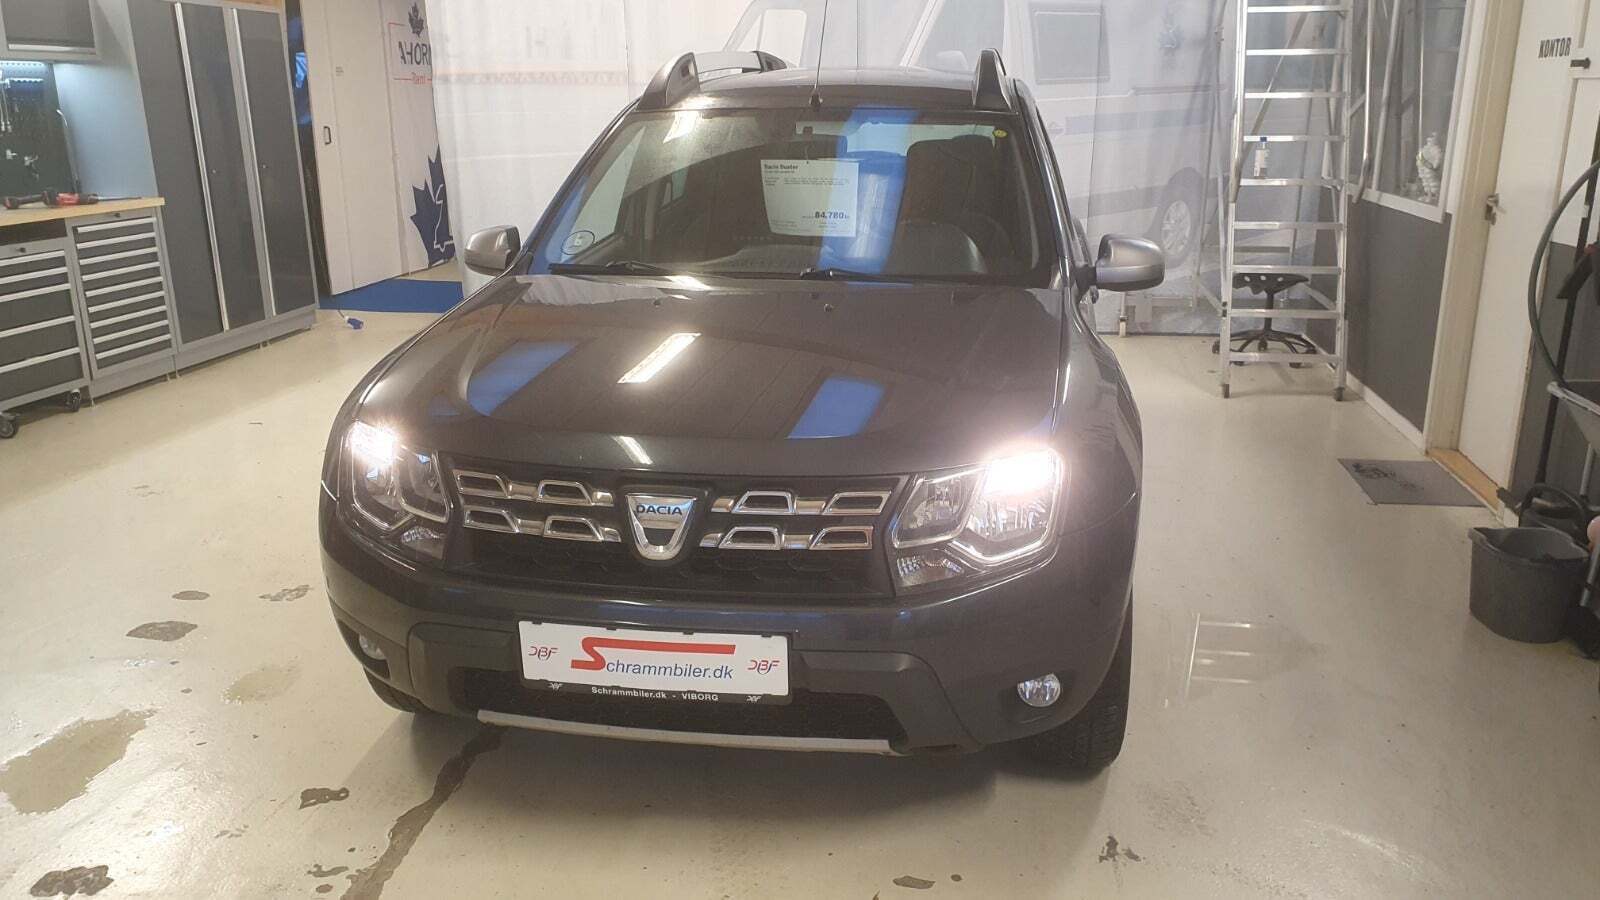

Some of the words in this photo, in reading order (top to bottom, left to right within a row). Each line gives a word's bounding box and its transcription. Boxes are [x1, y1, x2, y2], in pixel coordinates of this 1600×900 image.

[1538, 36, 1572, 59] KONTOR
[636, 504, 683, 516] DACIA
[570, 636, 736, 679] Schrammbiler.dk
[591, 686, 667, 699] Schrammbiler.dk
[681, 692, 719, 701] VIBORG
